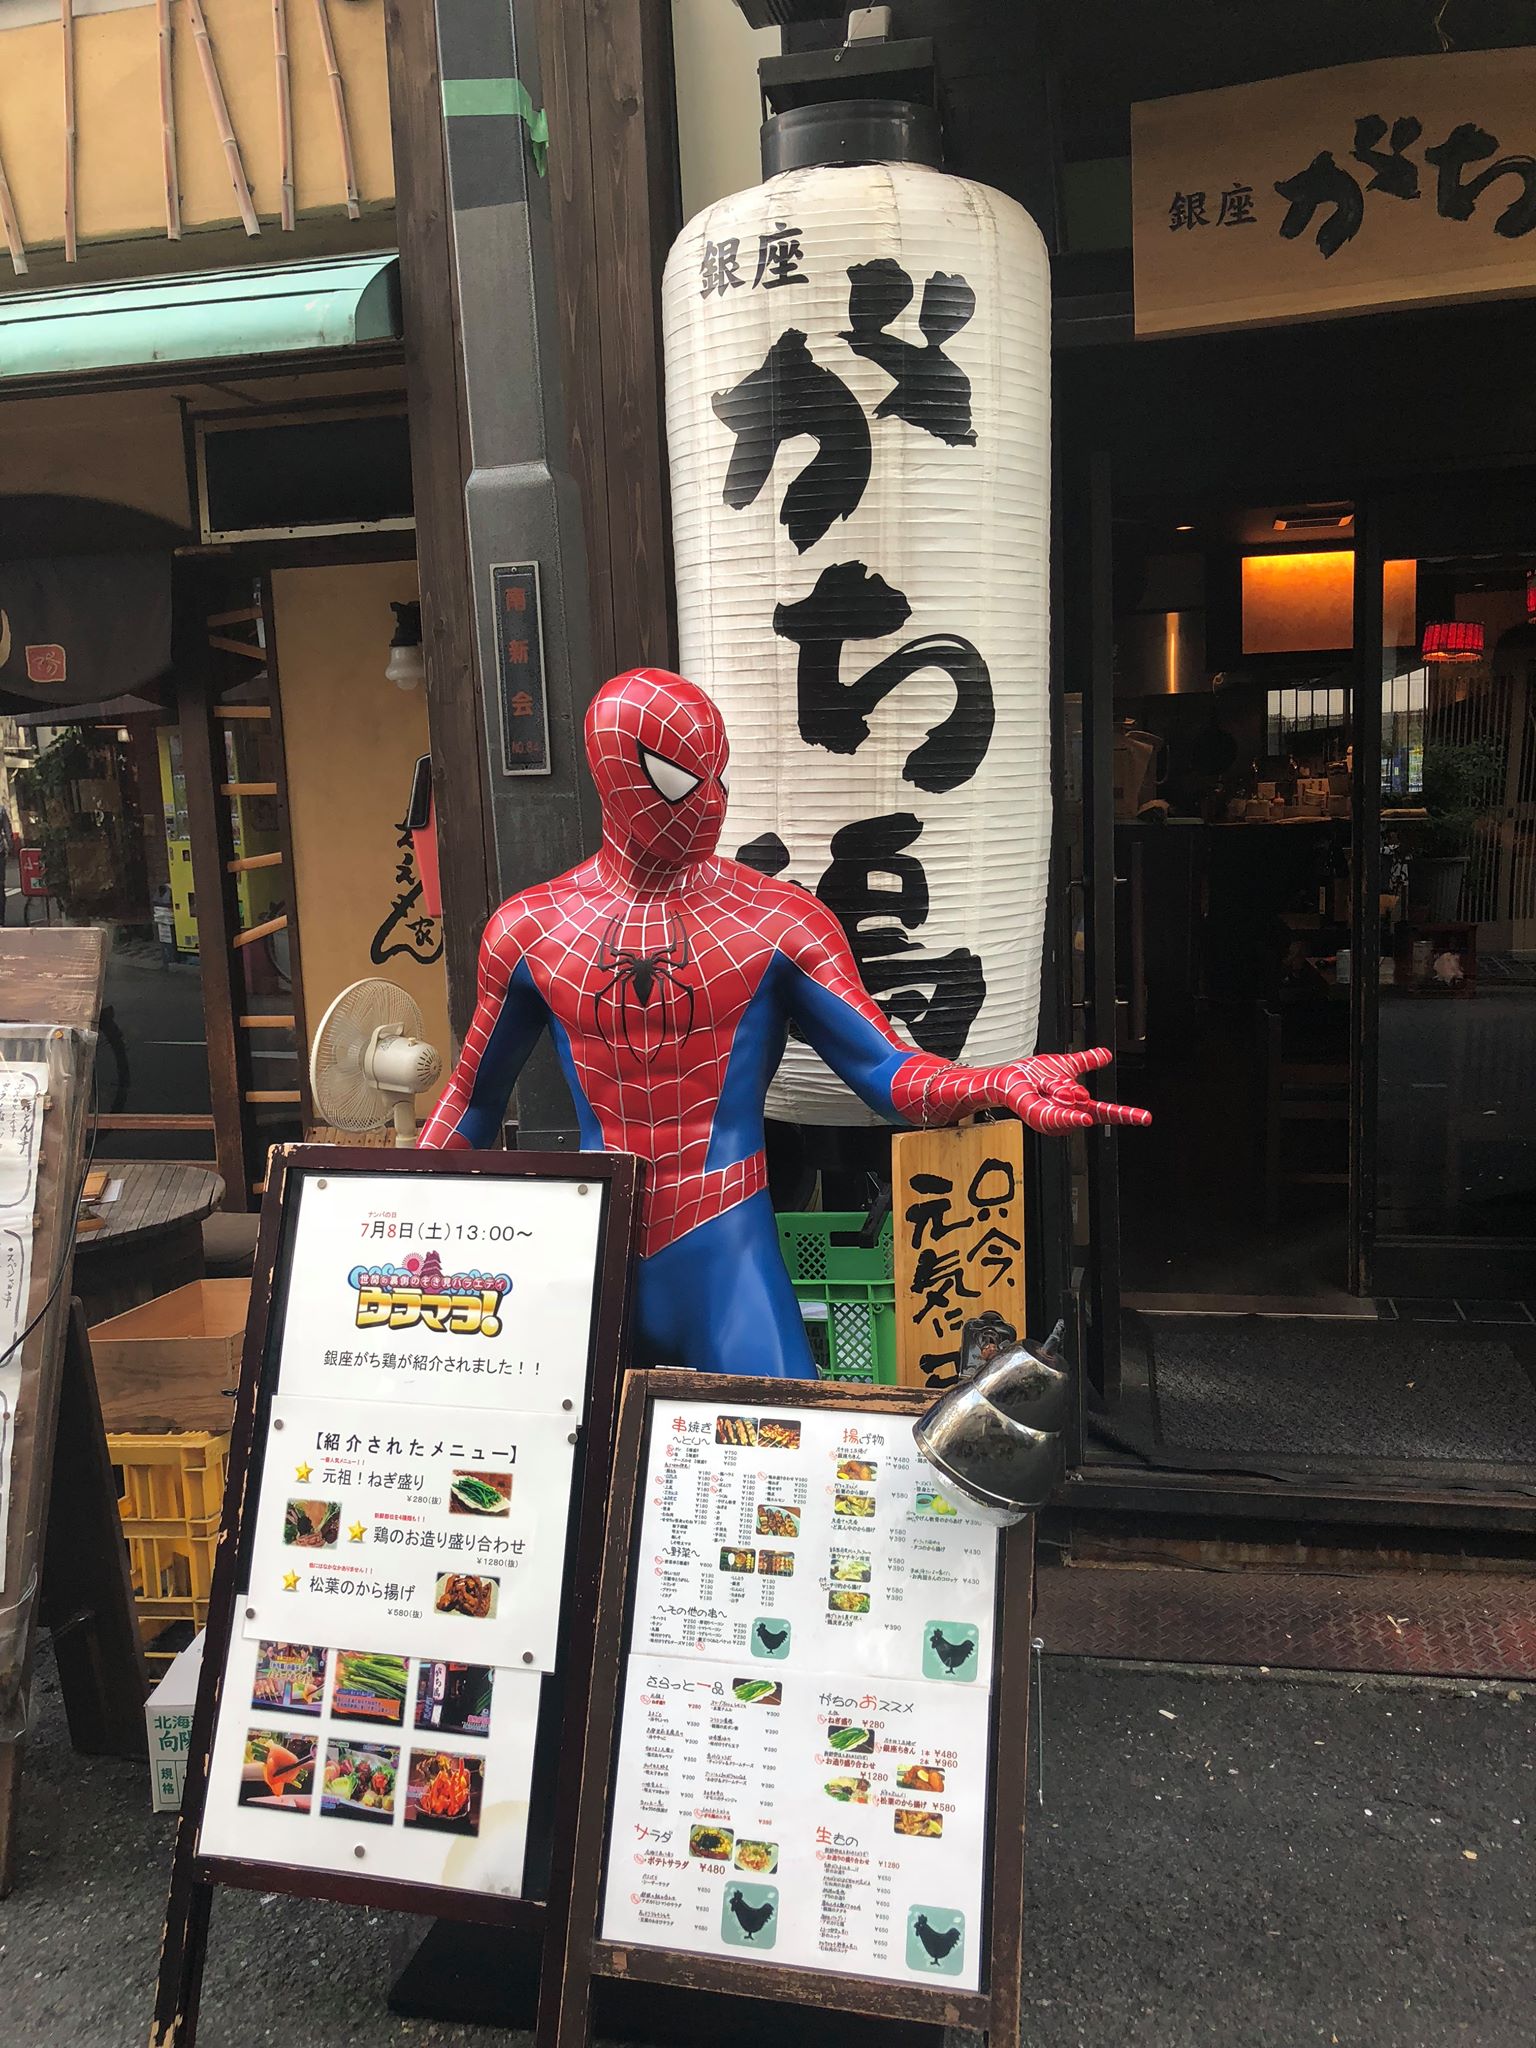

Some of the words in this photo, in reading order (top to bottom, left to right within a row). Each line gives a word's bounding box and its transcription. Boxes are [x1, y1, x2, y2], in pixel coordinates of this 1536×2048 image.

[1167, 182, 1258, 232] 銀座
[698, 221, 809, 299] 銀座
[672, 1416, 712, 1434] 串焼き
[842, 1427, 885, 1447] 揚げ物
[322, 1467, 425, 1492] 元祖！ねぎ盛り
[373, 1526, 526, 1555] 鶏のお造り盛り合わせ
[309, 1576, 416, 1602] 松葉のから揚げ
[646, 1675, 725, 1696] さらっと一品
[818, 1692, 914, 1713] がちのおススメ
[154, 1715, 195, 1730] 北海
[862, 1719, 885, 1729] ¥280
[934, 1749, 958, 1759] ¥480
[934, 1758, 958, 1768] ¥960
[161, 1767, 175, 1795] 規格
[860, 1771, 888, 1782] ¥1280
[932, 1802, 956, 1812] ¥580
[634, 1823, 674, 1844] サラダ
[816, 1826, 859, 1848] 生もの
[647, 1857, 690, 1870] ポテトサラダ
[699, 1862, 726, 1875] ¥480
[878, 1861, 900, 1870] ¥1280
